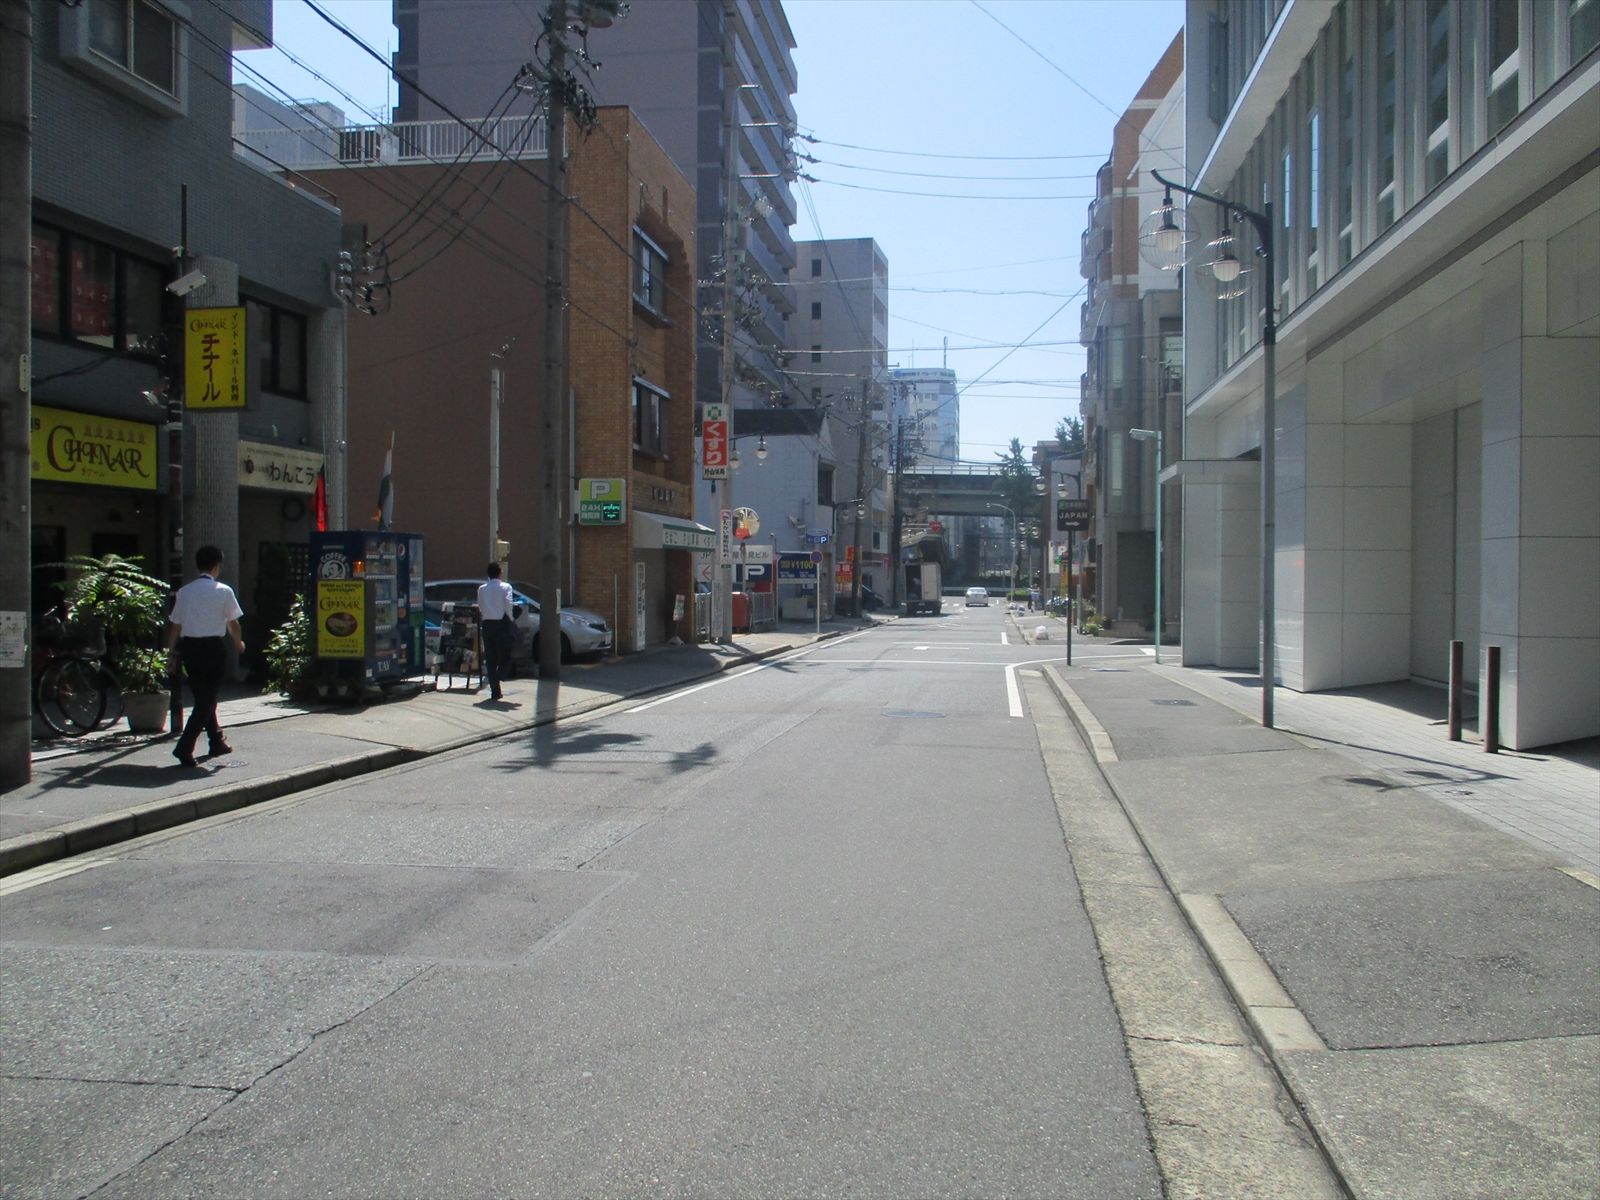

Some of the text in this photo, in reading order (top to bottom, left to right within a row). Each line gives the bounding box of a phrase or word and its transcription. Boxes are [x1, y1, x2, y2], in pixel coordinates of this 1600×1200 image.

[201, 333, 221, 402] チナール
[47, 425, 150, 478] CHINAR
[705, 423, 724, 465] くすり
[591, 481, 611, 500] P
[820, 536, 827, 544] P
[745, 565, 765, 581] P
